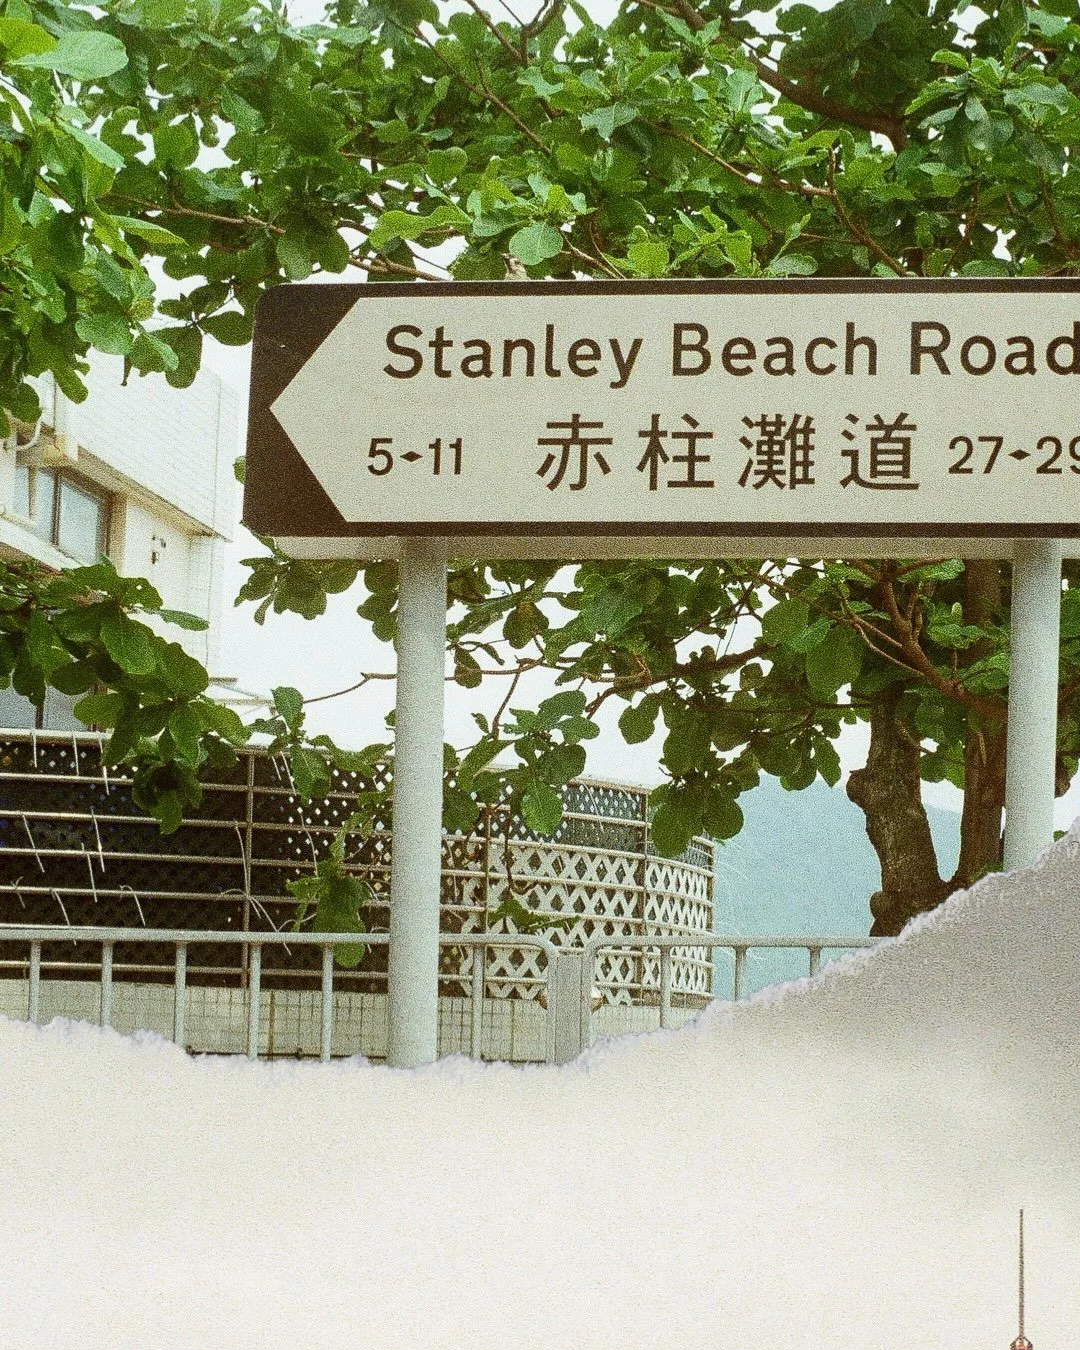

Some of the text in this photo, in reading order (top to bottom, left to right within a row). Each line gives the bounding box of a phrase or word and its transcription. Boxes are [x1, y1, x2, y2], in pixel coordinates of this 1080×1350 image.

[383, 322, 643, 389] Stanley
[672, 322, 879, 377] Beach
[535, 411, 921, 492] 赤柱灘道
